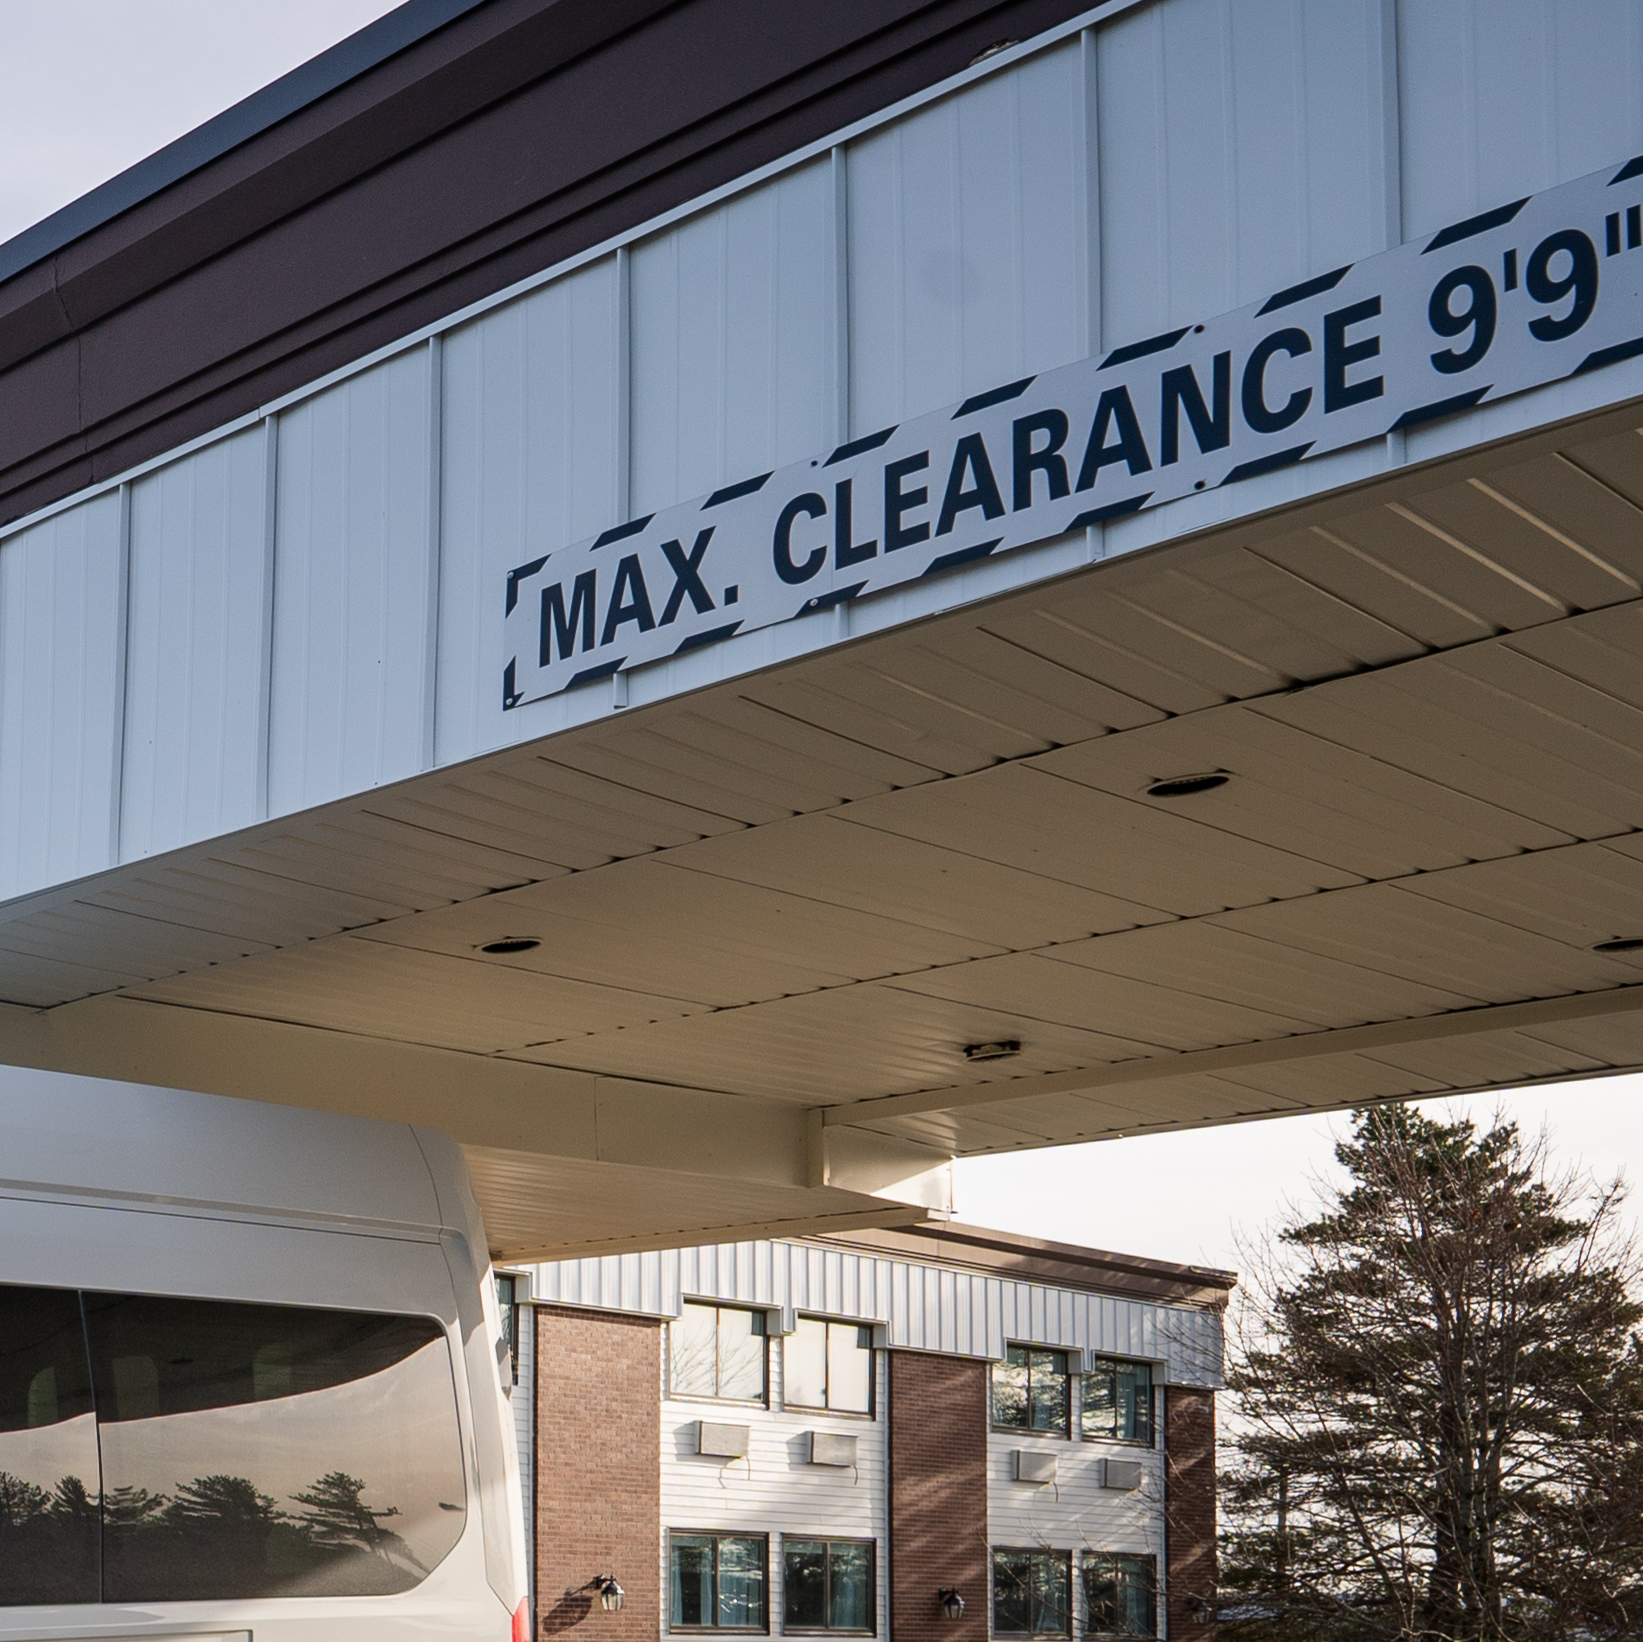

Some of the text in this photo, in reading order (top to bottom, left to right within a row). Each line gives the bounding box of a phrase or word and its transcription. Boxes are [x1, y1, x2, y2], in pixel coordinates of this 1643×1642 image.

[537, 203, 1643, 669] MAX. CLEARANCE 9'9"
